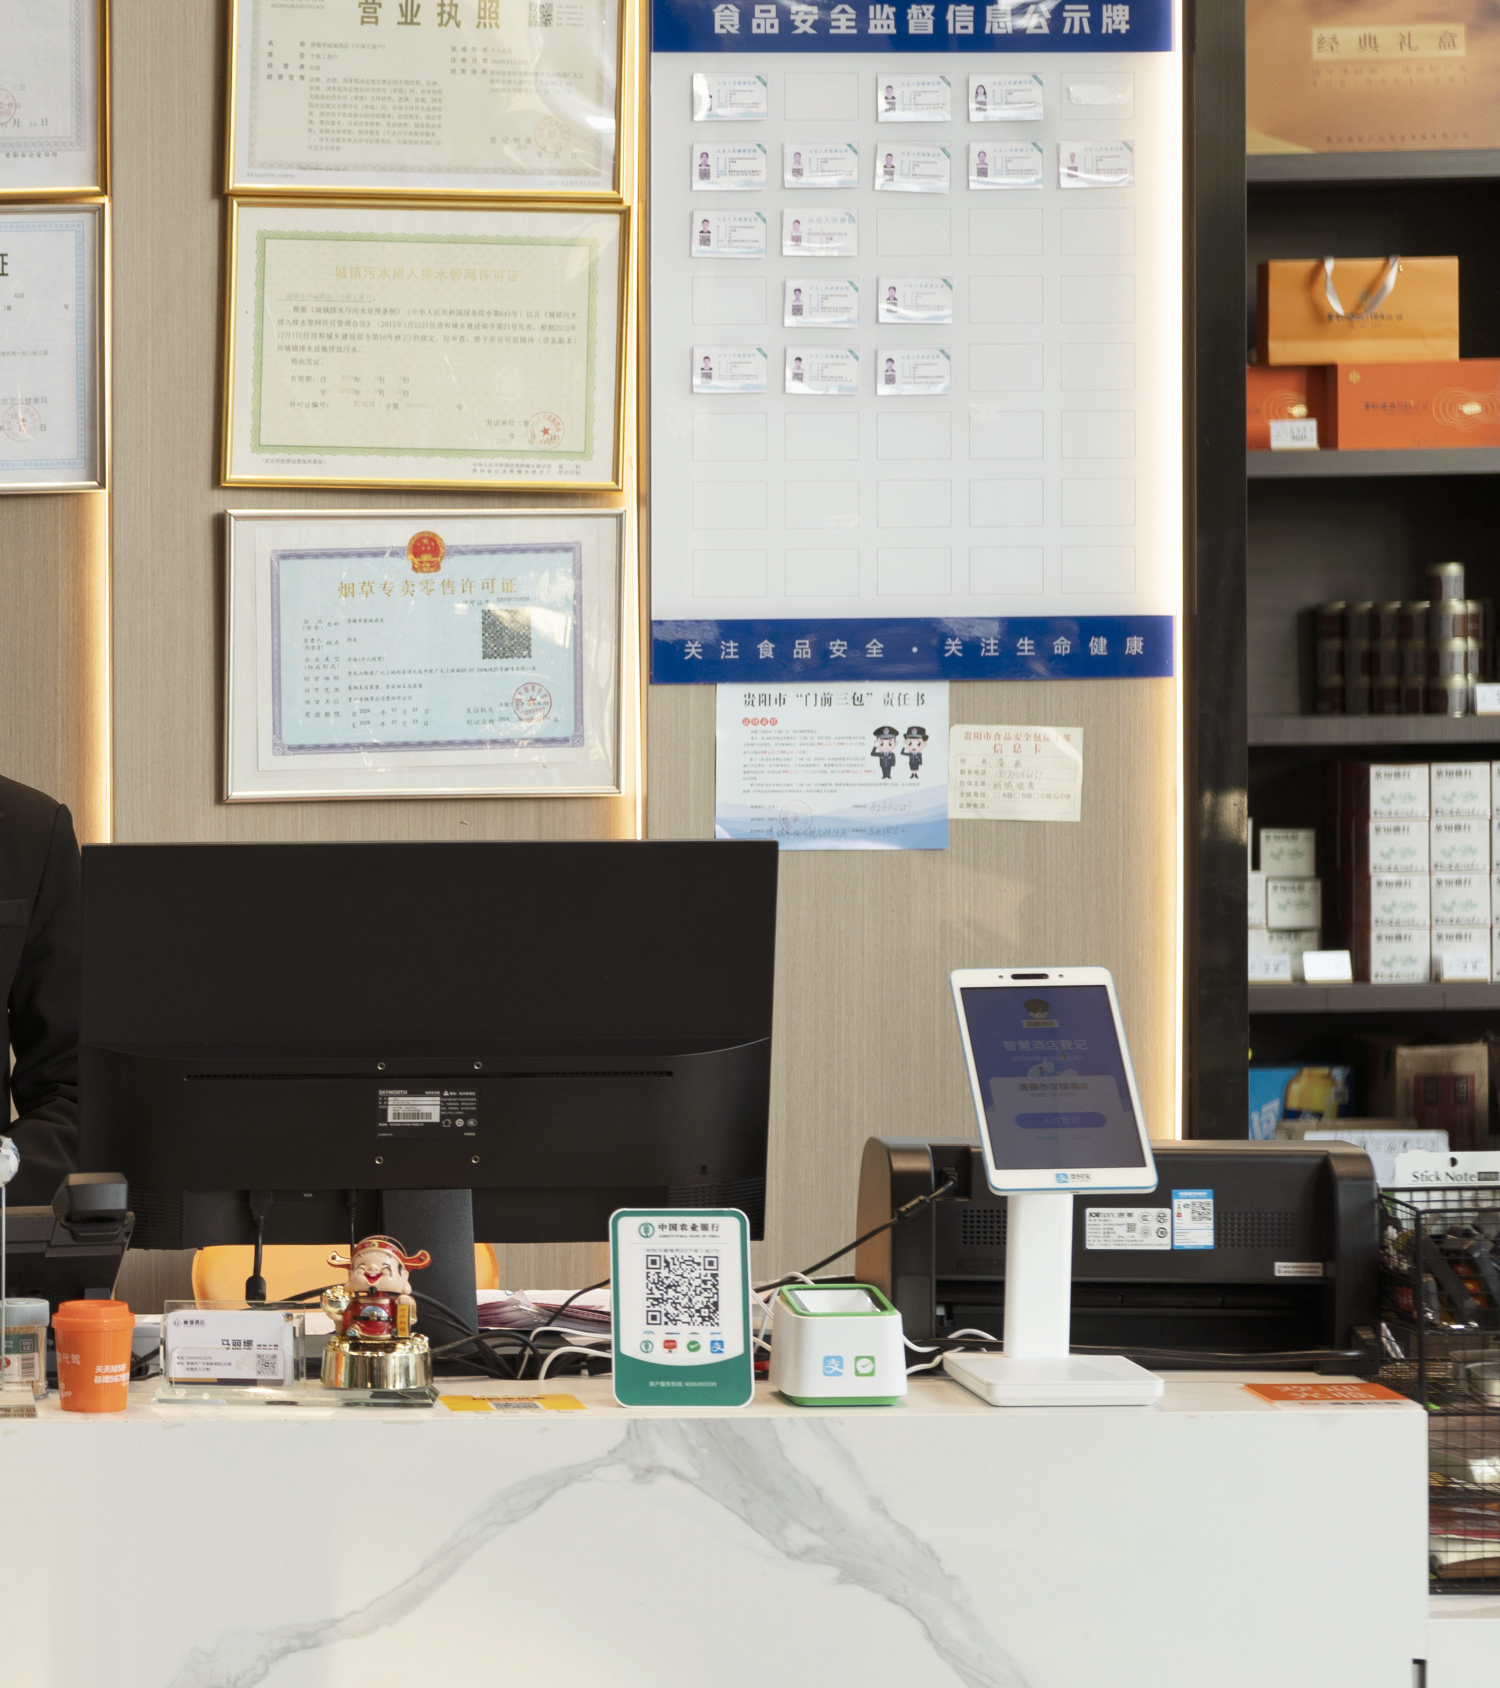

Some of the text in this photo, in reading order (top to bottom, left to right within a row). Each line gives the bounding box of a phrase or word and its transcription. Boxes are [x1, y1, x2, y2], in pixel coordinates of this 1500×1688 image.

[713, 4, 1130, 35] 食品安全监督信息公示牌
[1315, 28, 1459, 54] 经典礼盒
[41, 118, 49, 127] 日
[334, 265, 519, 283] 城镇污水排入排水管网许可证
[337, 577, 518, 599] 烟草专卖零售许可证
[743, 692, 925, 707] 贵阳市“门前三包”责任书
[993, 743, 1041, 755] 信息卡
[1412, 1170, 1476, 1182] Stick Note
[658, 1223, 720, 1232] 中国农业银行
